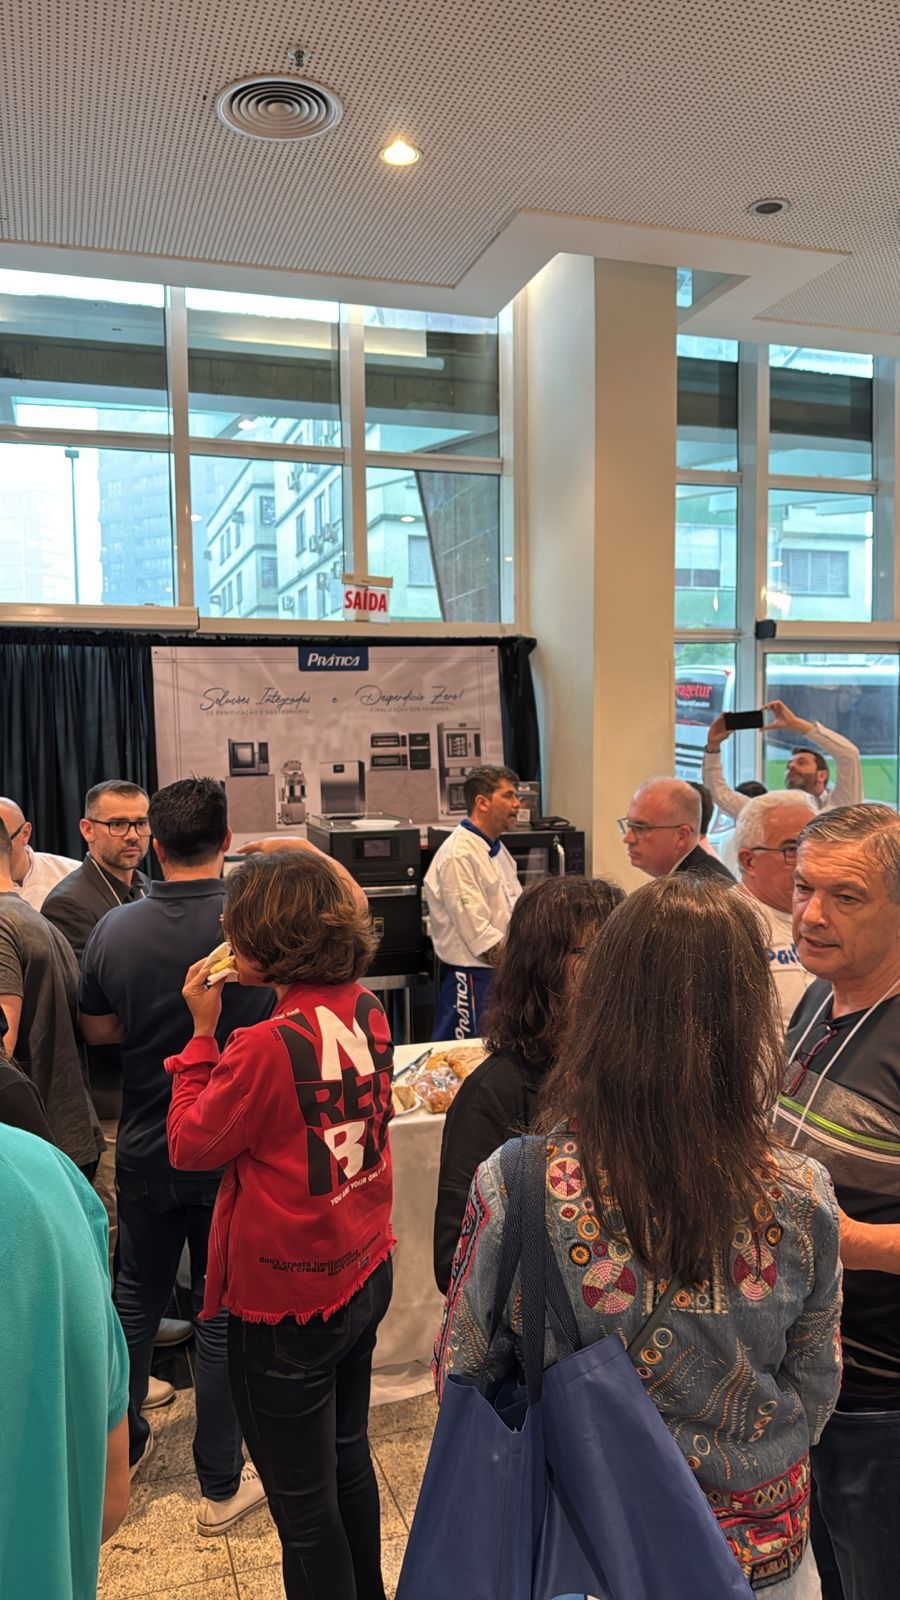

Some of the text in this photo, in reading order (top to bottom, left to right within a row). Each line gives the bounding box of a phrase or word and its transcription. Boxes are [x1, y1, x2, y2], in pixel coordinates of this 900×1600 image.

[344, 588, 387, 612] SAÍDA
[307, 653, 360, 666] PRÁTICA
[331, 1193, 342, 1206] YOU
[350, 1177, 367, 1190] YOUR
[367, 1168, 382, 1181] ONLY
